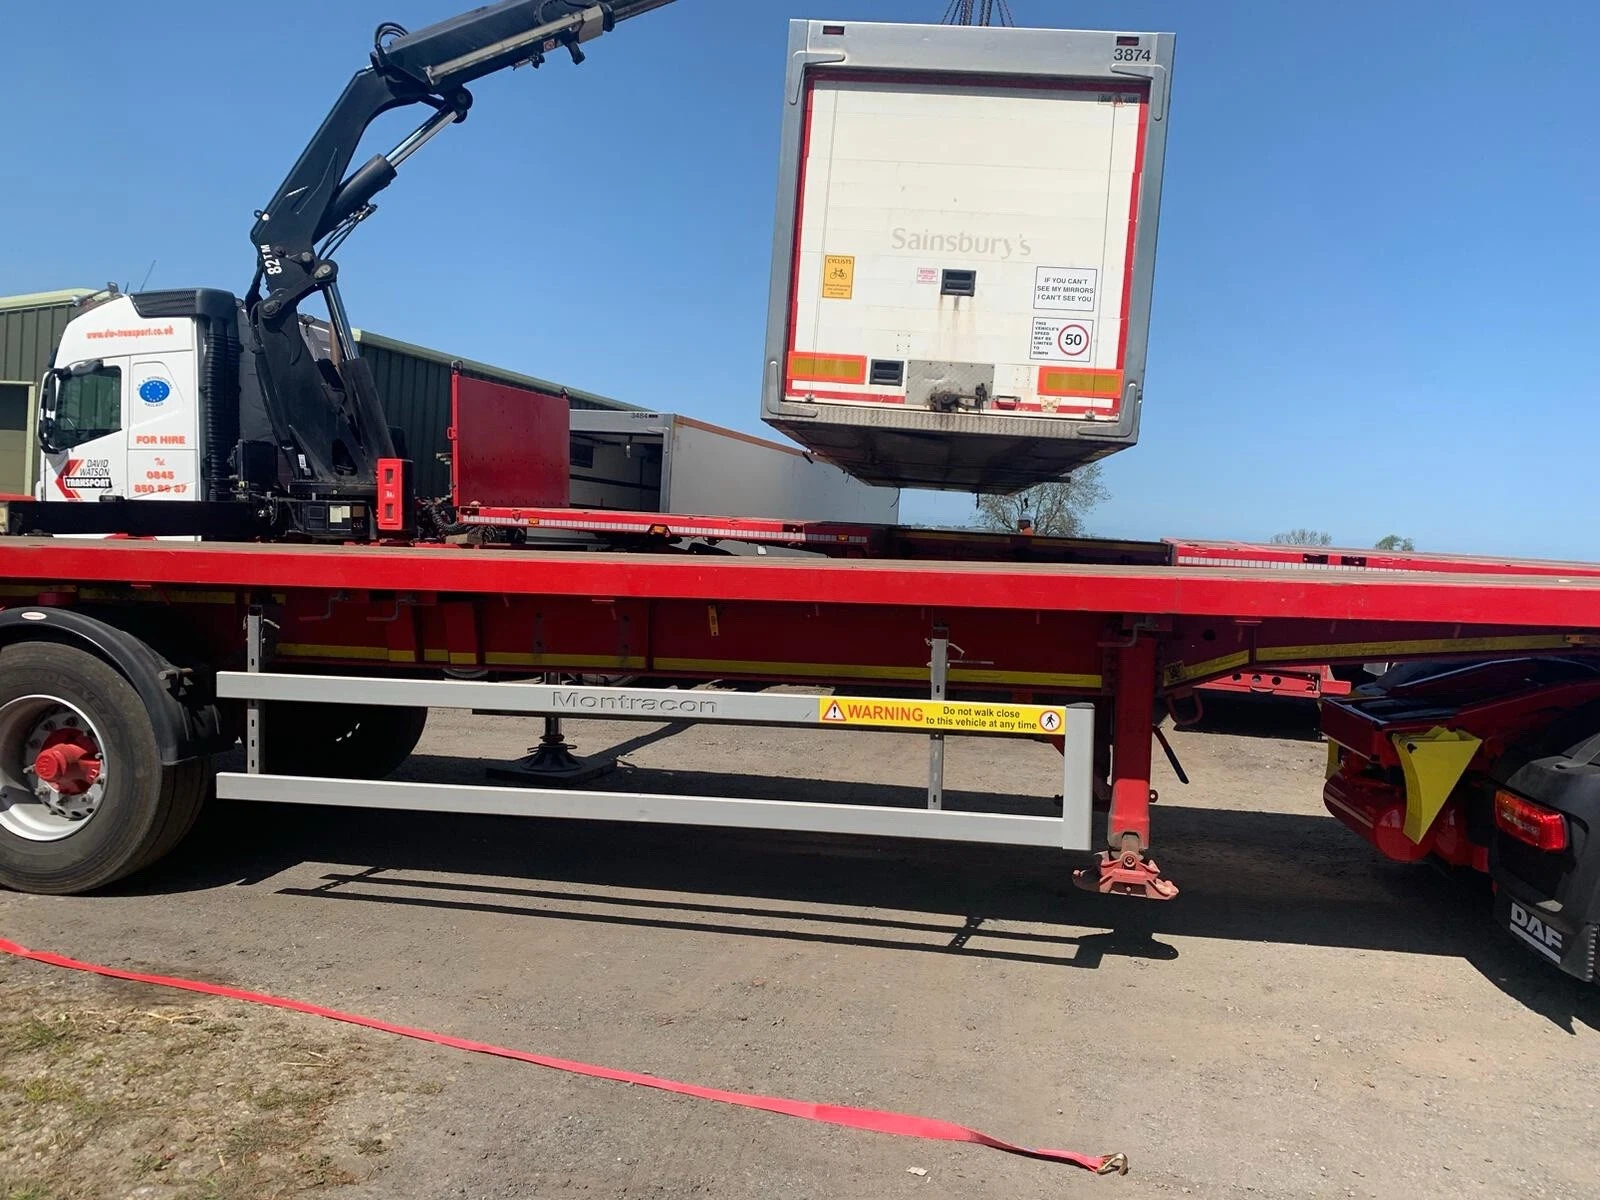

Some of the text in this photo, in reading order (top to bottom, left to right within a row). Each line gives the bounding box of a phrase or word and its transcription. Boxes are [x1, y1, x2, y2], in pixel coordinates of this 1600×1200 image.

[1113, 48, 1151, 62] 3874
[891, 227, 1032, 260] Sainsbury's
[1063, 286, 1094, 294] MIRRORS
[1064, 333, 1083, 346] 50
[136, 435, 186, 445] FOR HIRE
[86, 459, 109, 468] DAVID
[79, 467, 111, 477] WATSON
[146, 470, 175, 481] 0845
[66, 477, 111, 488] TRANSPORT
[552, 691, 718, 713] Montracon
[848, 704, 1020, 722] WARNING Do not walk close
[926, 716, 1037, 731] to this vehicle at any time
[1511, 902, 1562, 949] DAF
